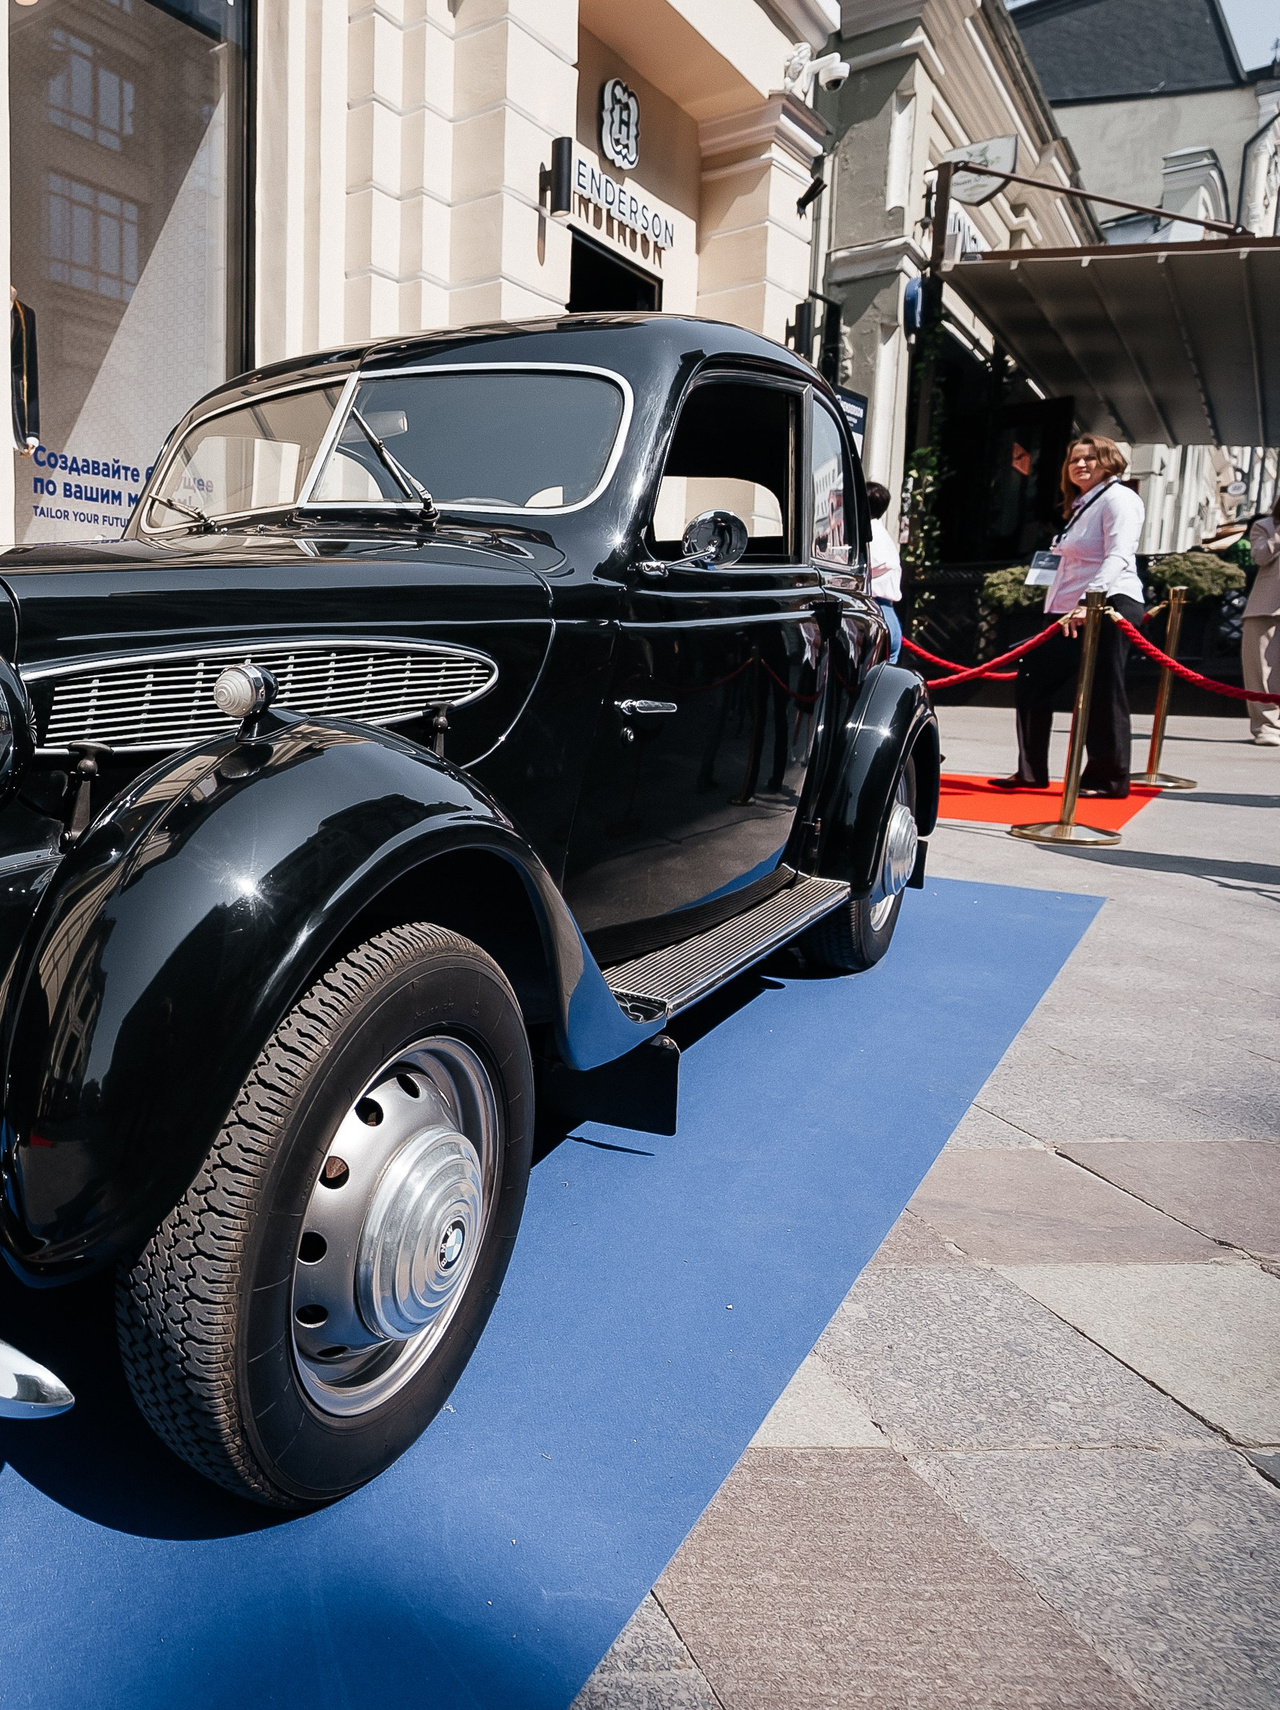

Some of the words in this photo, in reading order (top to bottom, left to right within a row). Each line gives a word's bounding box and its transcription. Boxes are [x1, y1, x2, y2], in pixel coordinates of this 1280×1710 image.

[573, 157, 674, 248] ENDERSON
[33, 445, 140, 483] Создавайте
[33, 477, 57, 496] по
[63, 482, 122, 507] вашим
[33, 505, 70, 521] TAILOR
[72, 511, 99, 525] YOUR
[102, 515, 130, 528] FUTU
